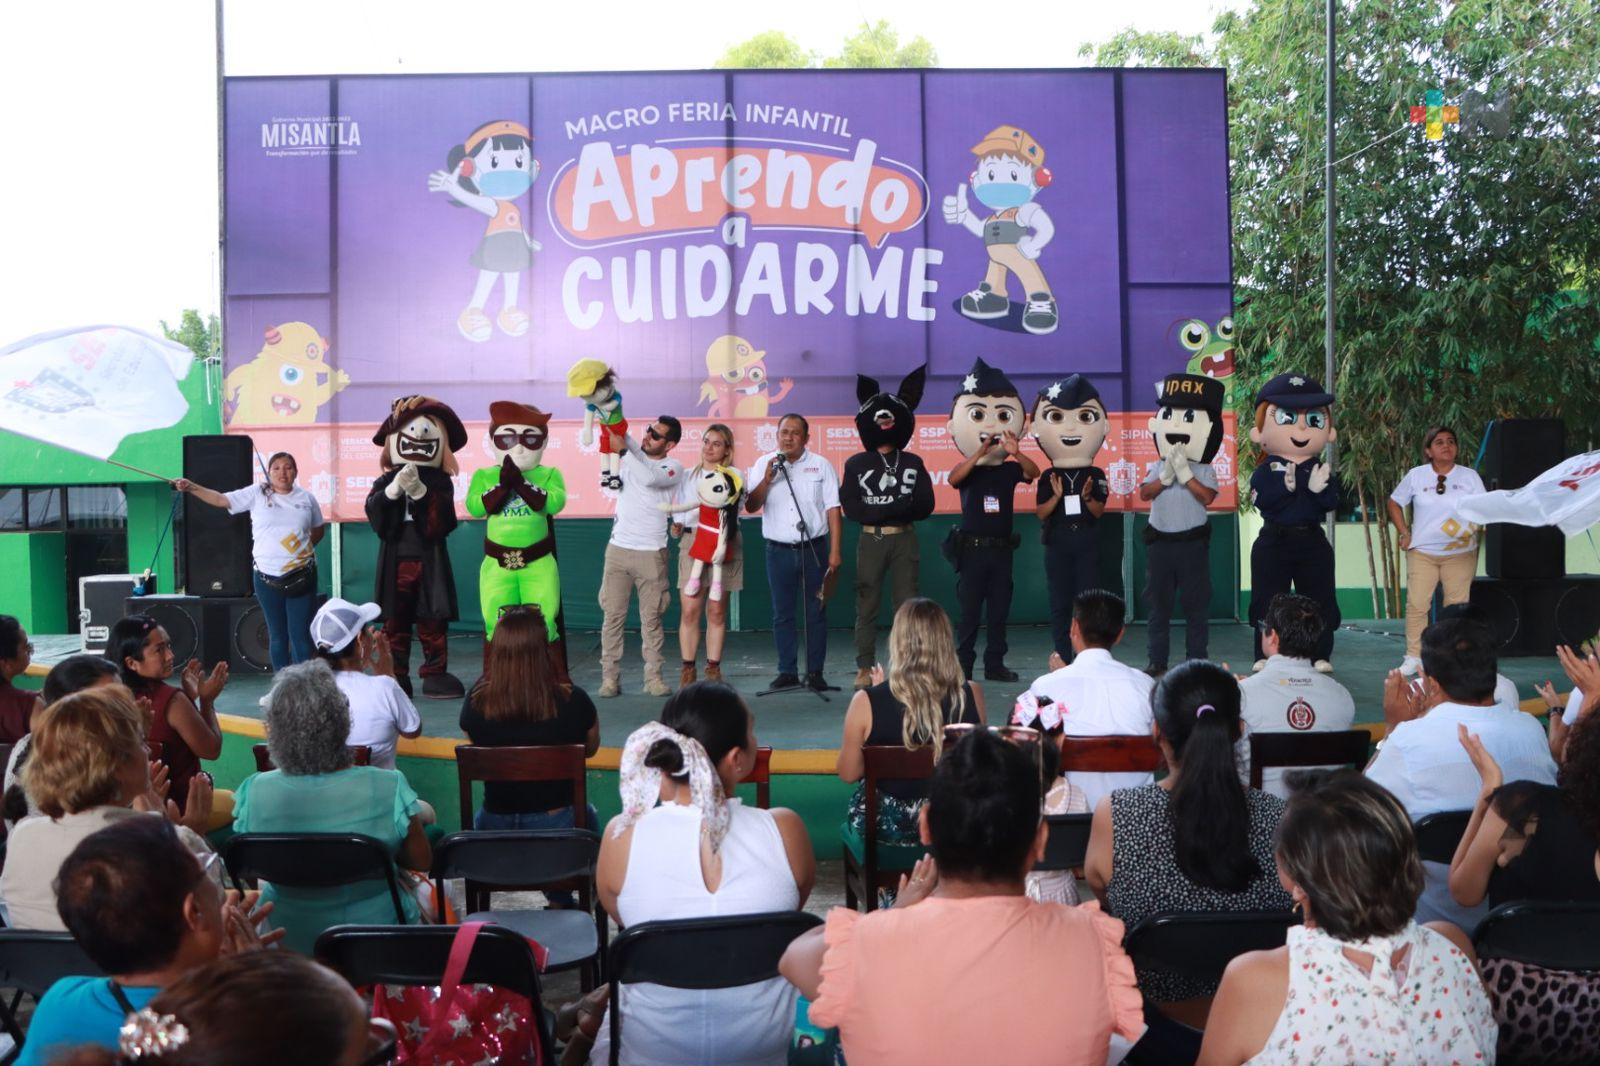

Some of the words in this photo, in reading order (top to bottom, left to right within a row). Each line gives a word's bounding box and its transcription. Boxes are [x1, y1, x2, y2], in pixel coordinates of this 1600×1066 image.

[261, 122, 361, 147] MISANTLA
[564, 104, 660, 140] MACRO
[668, 101, 738, 123] FERIA
[745, 103, 852, 138] INFANTIL
[572, 138, 909, 231] Aprendo
[722, 215, 747, 248] a
[562, 242, 943, 330] CUIDARME
[919, 427, 946, 438] SSP
